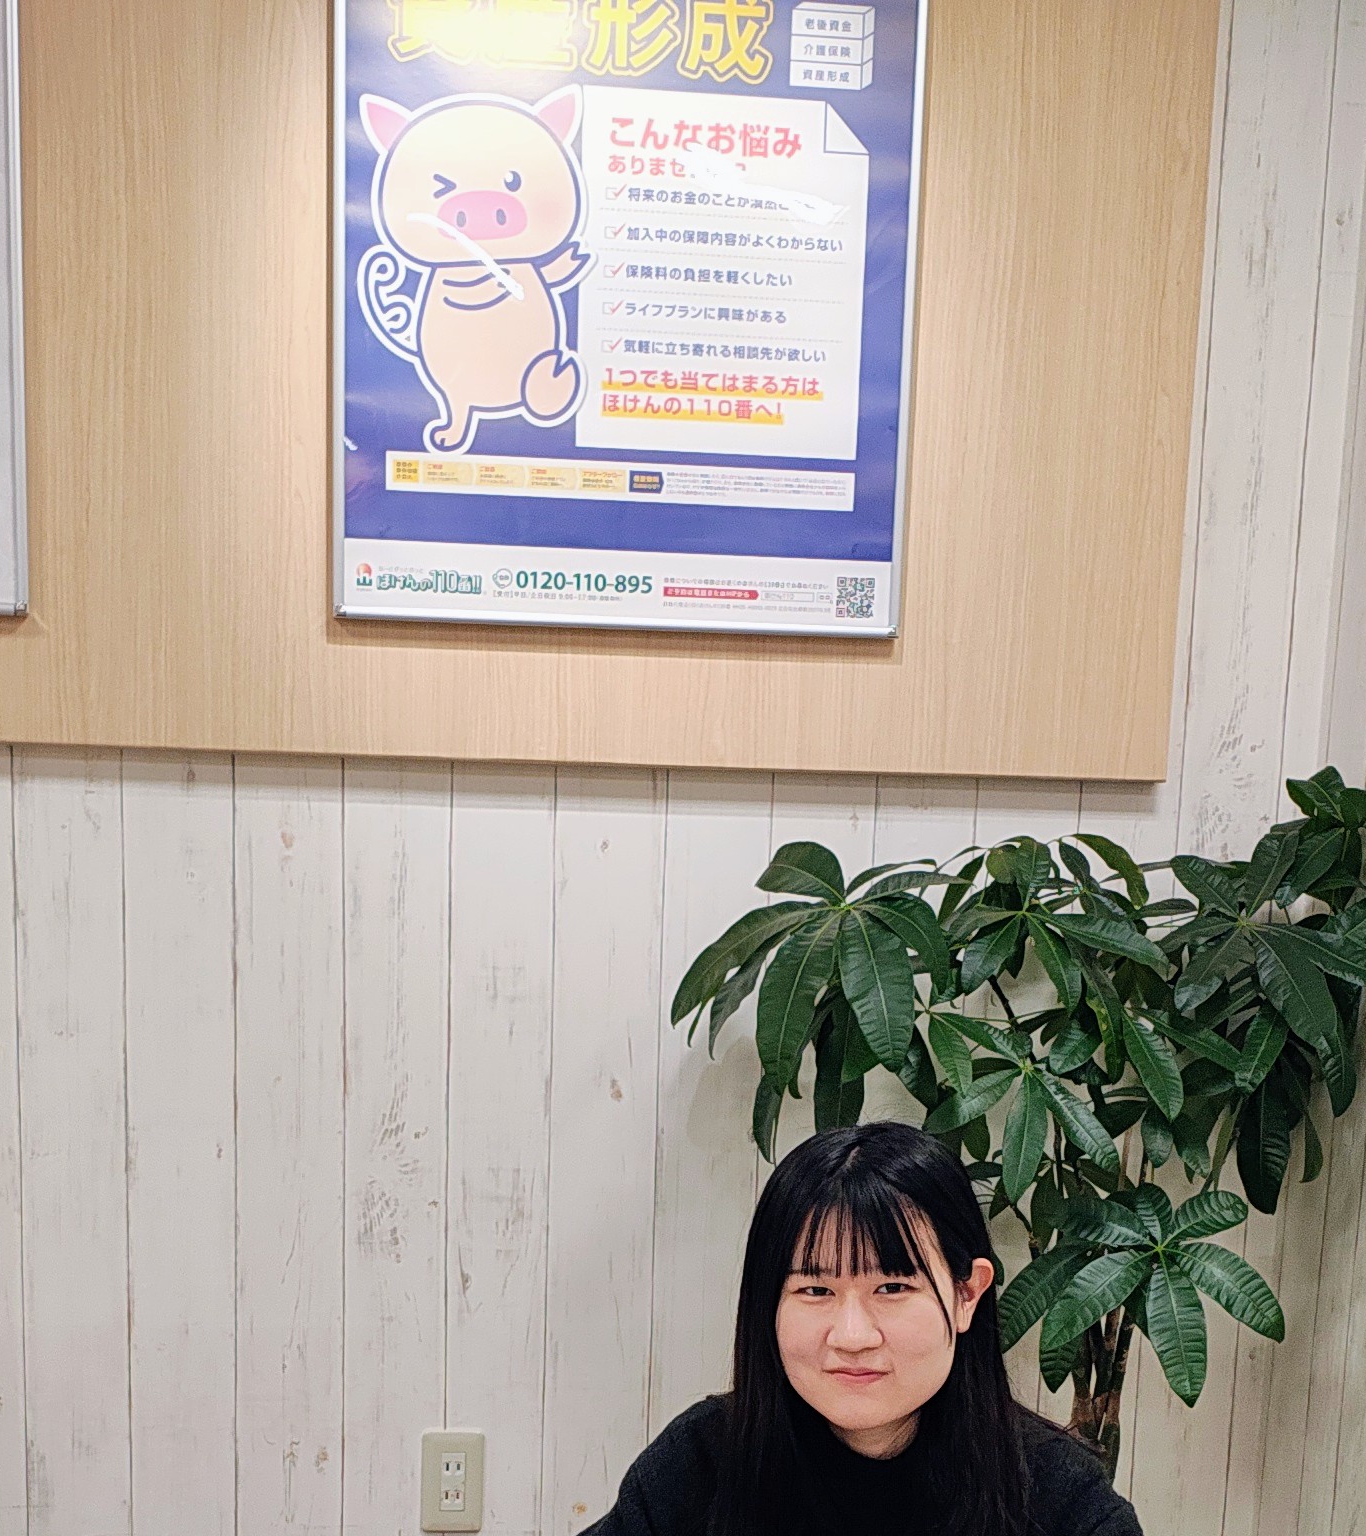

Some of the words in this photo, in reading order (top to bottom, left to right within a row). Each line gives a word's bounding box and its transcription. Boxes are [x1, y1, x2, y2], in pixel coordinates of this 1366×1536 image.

[805, 18, 852, 32] 老後資金
[804, 44, 851, 58] 介護保険
[609, 117, 803, 159] こんなお悩み
[626, 227, 844, 252] 加入中の保障内容がよくわからない
[625, 264, 793, 287] 保険料の負担を軽くしたい
[624, 302, 788, 324] ライフプランに興味がある
[623, 339, 827, 362] 気軽に立ち寄れる相談先が欲しい
[604, 367, 820, 396] 1つでも当てはまる方は
[602, 393, 783, 420] ほけんの110番へ!
[515, 570, 653, 595] 0120-110-895
